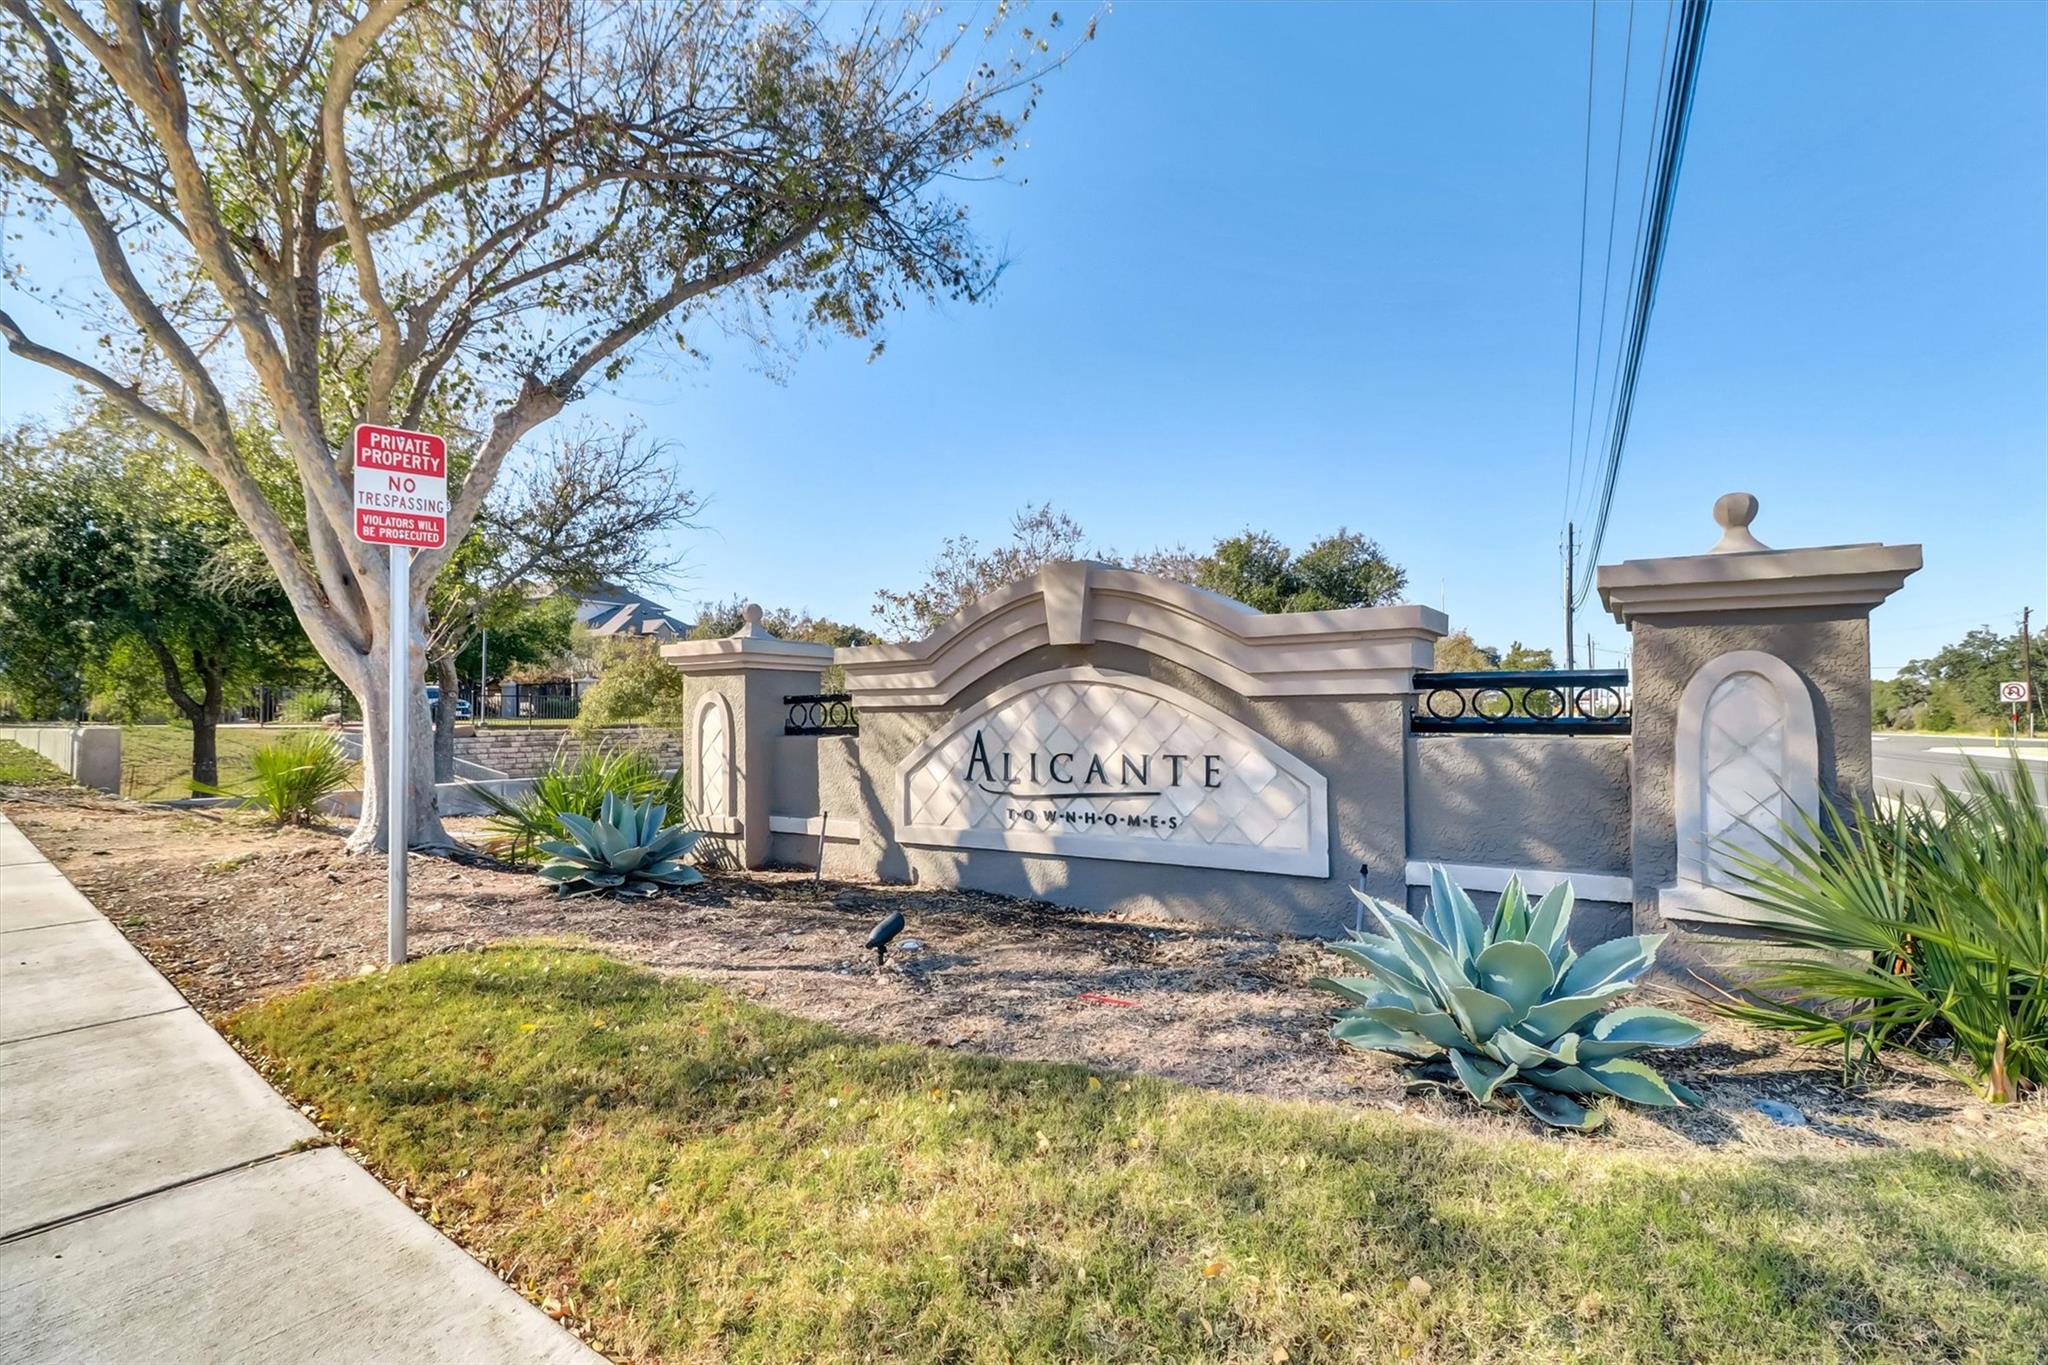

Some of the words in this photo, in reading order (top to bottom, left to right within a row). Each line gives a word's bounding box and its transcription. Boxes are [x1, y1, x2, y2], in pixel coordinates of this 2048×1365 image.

[371, 433, 431, 455] PRIVATE
[362, 448, 440, 472] PROPERTY
[388, 476, 416, 493] NO
[358, 491, 444, 513] TRESPASSING
[362, 514, 414, 528] VIOLATORS
[418, 520, 439, 532] WILL
[363, 526, 375, 536] BE
[379, 528, 439, 542] PROSECUTED
[964, 730, 1222, 788] ALICANTE
